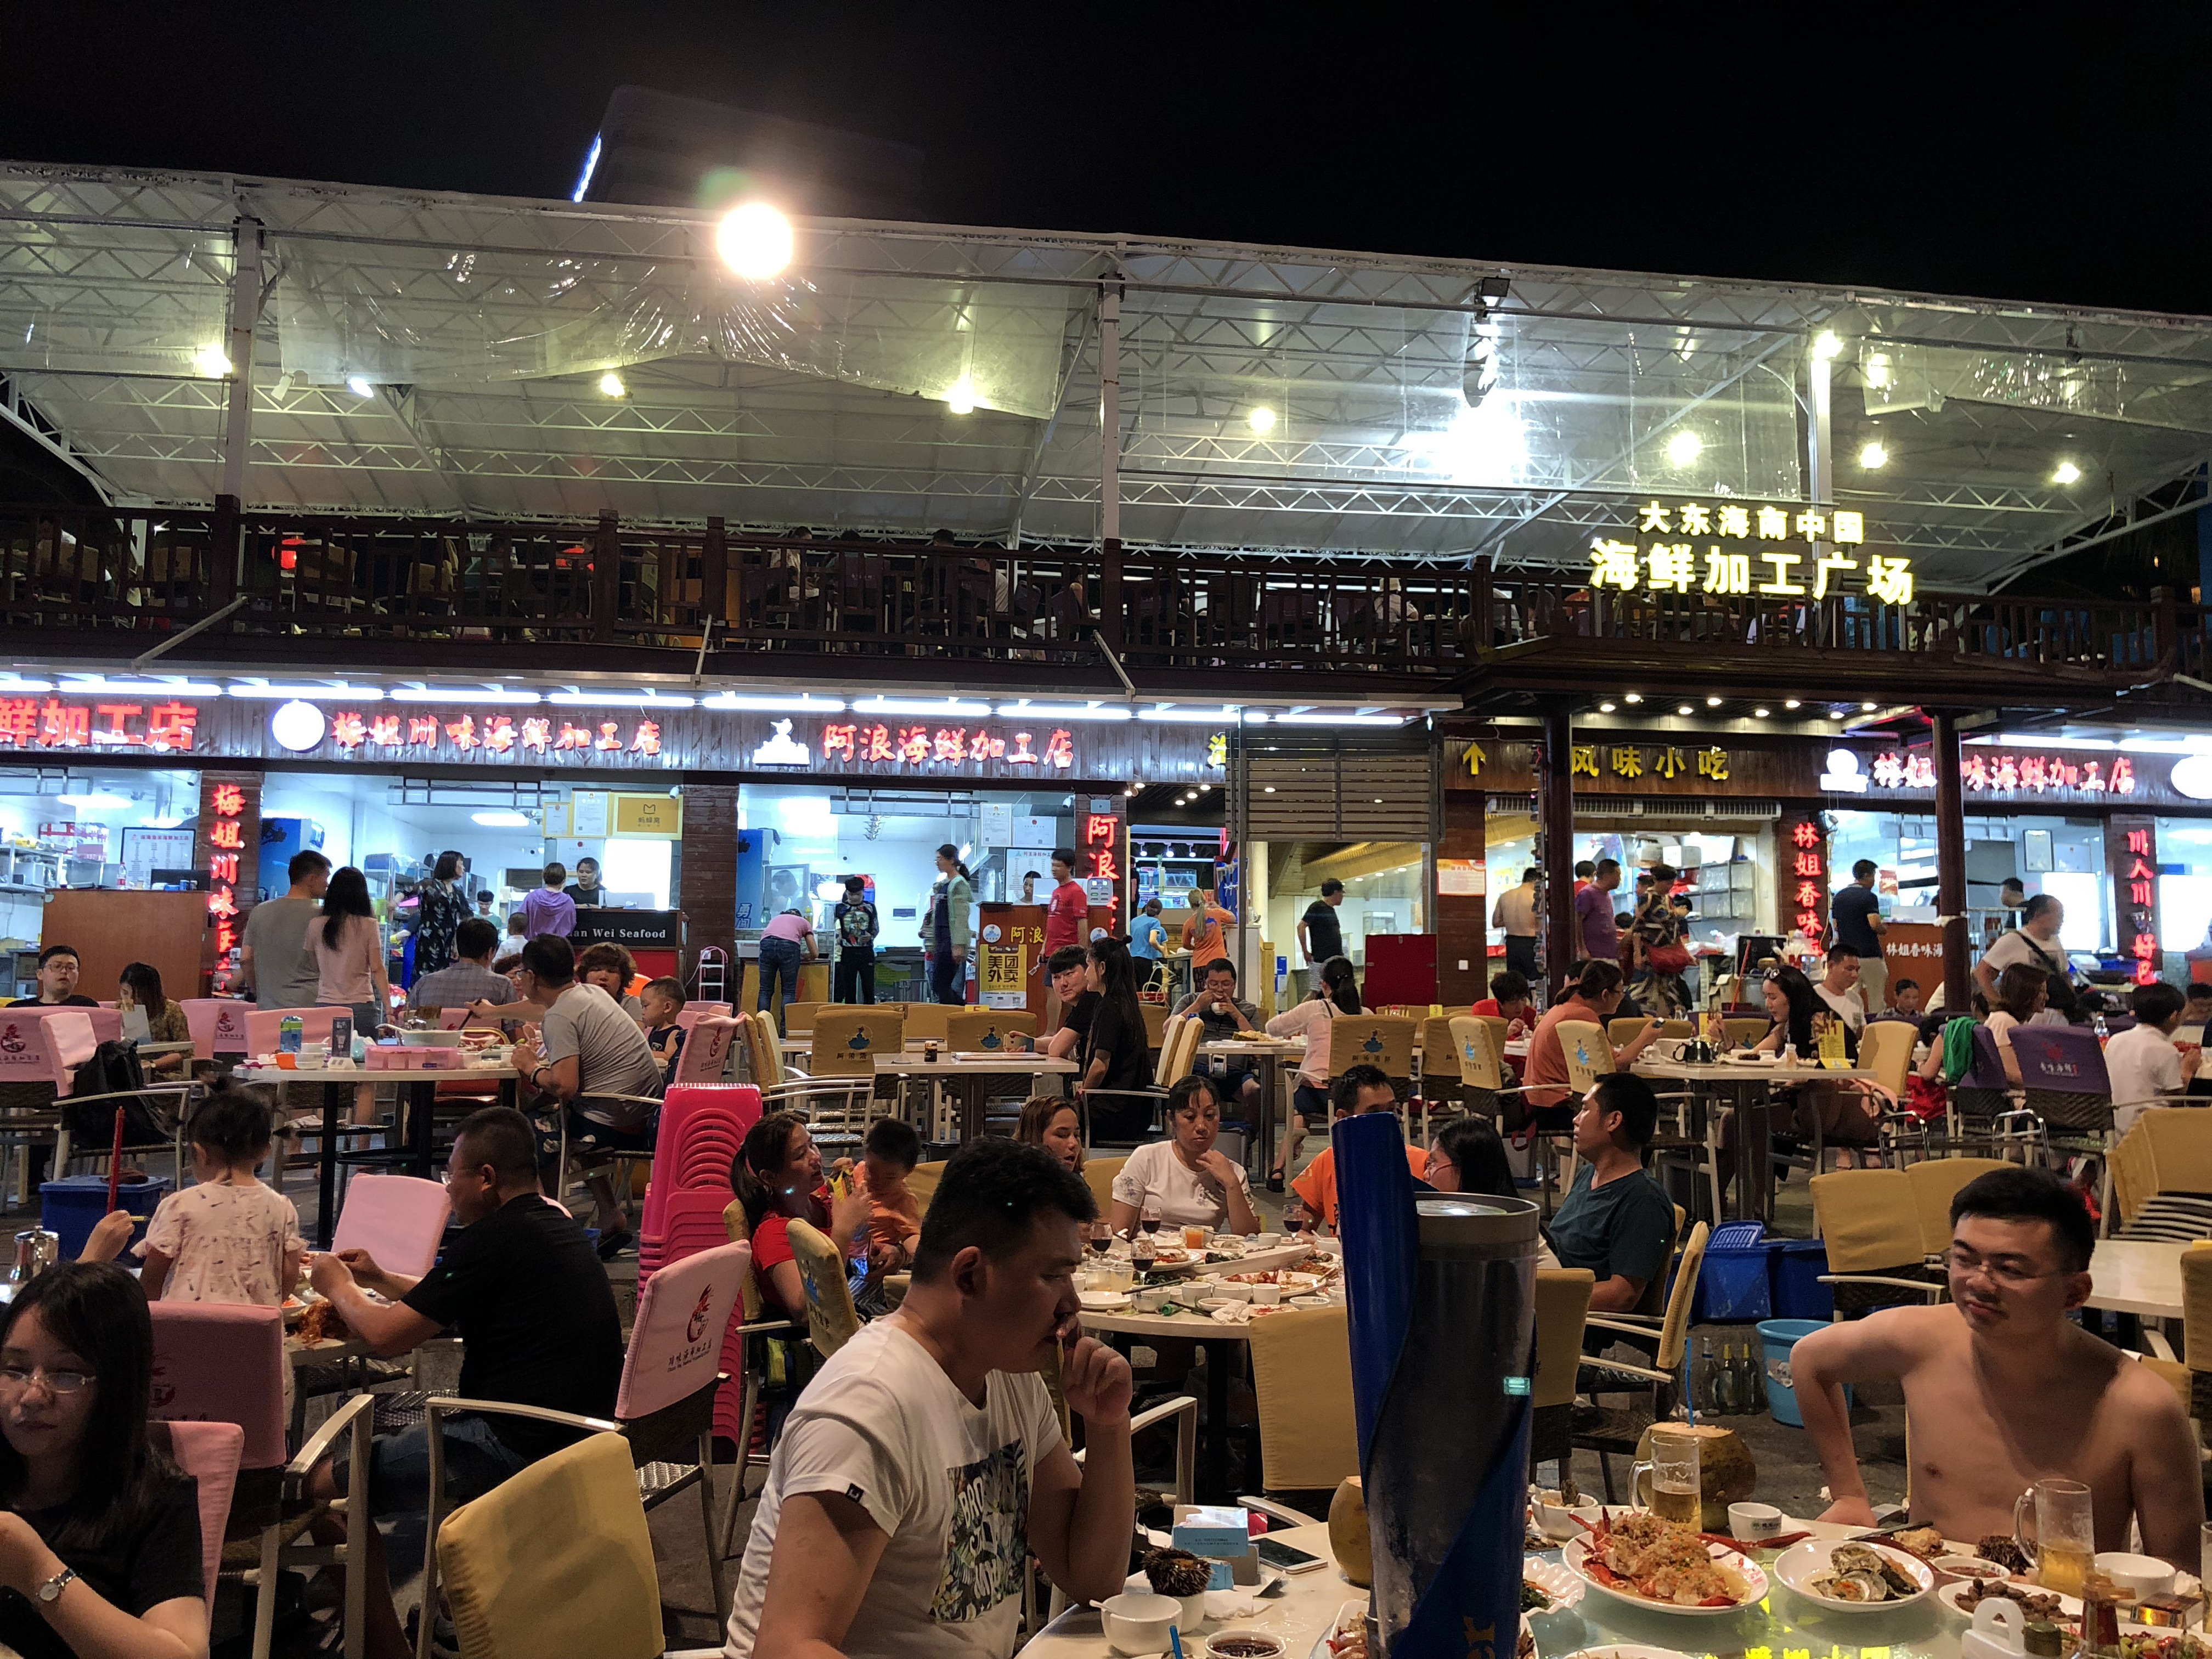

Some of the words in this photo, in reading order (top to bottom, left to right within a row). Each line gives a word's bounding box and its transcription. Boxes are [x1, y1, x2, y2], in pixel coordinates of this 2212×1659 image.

[1590, 538, 1915, 606] 海鲜加工广场
[0, 698, 198, 750] 鲜加工店
[332, 712, 662, 755] 梅姐川味海鲜加工店
[823, 723, 1074, 769] 阿浪海鲜加工店
[1571, 745, 1729, 780] 风味小吃
[1874, 752, 2135, 794] 林姐味海鲜加工店
[593, 928, 614, 938] Wei
[619, 929, 666, 939] Seafood
[1011, 926, 1043, 944] 阿浪
[988, 956, 1019, 969] 美团
[988, 969, 1019, 983] 外卖
